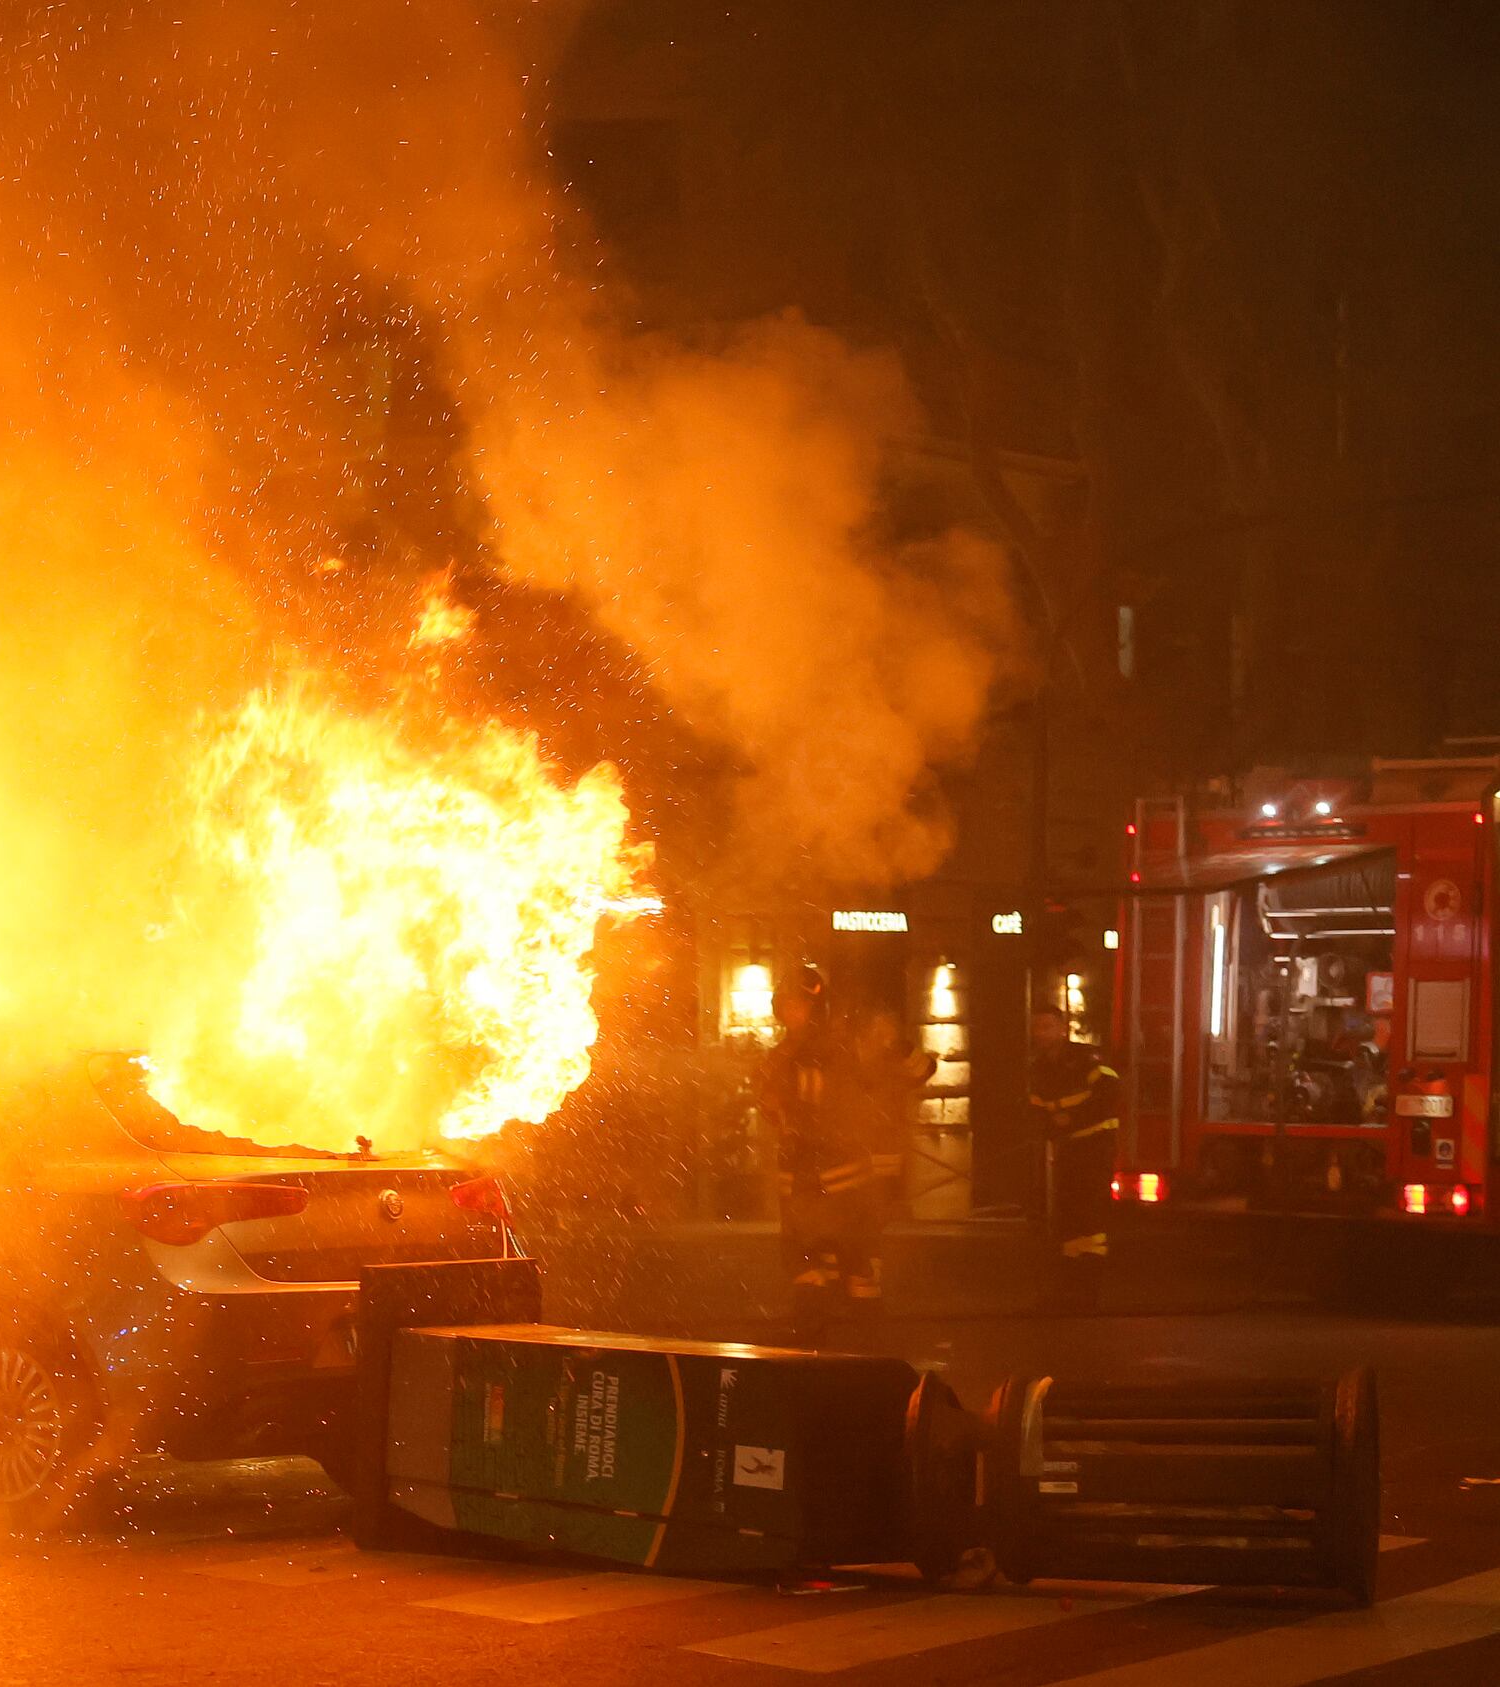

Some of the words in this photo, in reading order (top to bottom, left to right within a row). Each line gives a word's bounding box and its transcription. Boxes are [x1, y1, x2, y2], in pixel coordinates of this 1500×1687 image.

[833, 911, 908, 932] PASTICCERIA
[590, 1371, 604, 1409] CURA
[589, 1414, 602, 1431] DI
[601, 1375, 619, 1478] PRENDIAMOCI
